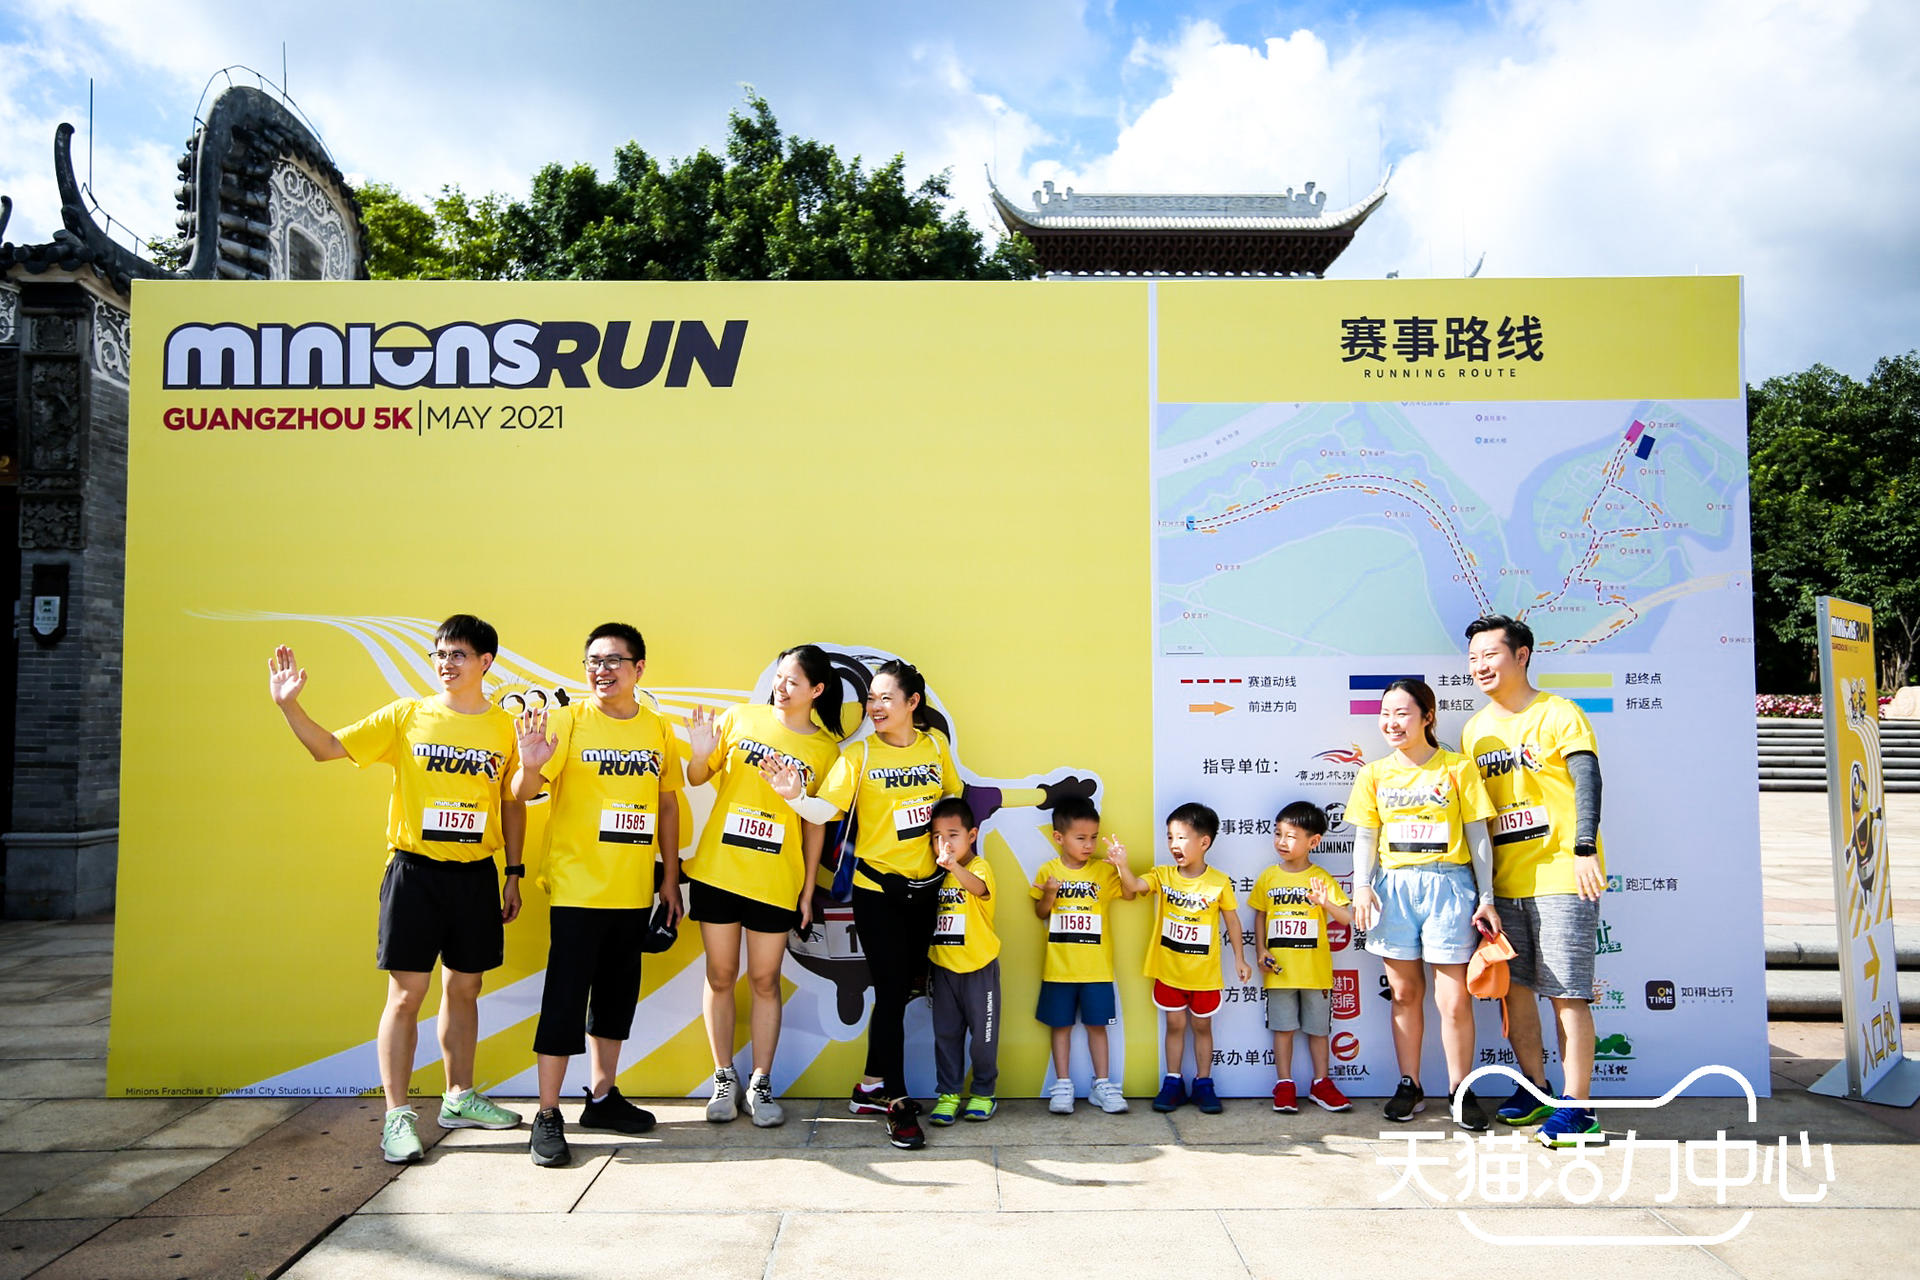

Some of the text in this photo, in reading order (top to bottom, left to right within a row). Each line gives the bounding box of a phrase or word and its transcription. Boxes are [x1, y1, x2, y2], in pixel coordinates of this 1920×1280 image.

[1341, 315, 1544, 363] 赛事路线
[1364, 368, 1517, 378] RUNNING ROUTE
[163, 406, 563, 431] GUANGZHOU 5K MAY 2021
[1248, 676, 1297, 688] 赛道动线
[1438, 674, 1474, 686] 主会场
[1625, 672, 1662, 685] 起终点
[1248, 700, 1297, 713] 前进方向
[1438, 699, 1474, 711] 集结区
[1625, 698, 1663, 710] 折返点
[426, 755, 480, 775] RUN
[598, 760, 645, 776] RUN
[885, 773, 928, 788] RUN
[439, 811, 475, 829] 11576
[615, 813, 645, 830] 11585
[907, 804, 932, 825] 1158
[1499, 810, 1533, 831] 11579
[738, 817, 773, 838] 11584
[1219, 818, 1278, 835] 事授权
[1400, 824, 1433, 839] 11577
[1626, 877, 1678, 891] 跑汇体育
[1056, 888, 1086, 898] RUN
[1273, 895, 1304, 905] RUN
[1167, 894, 1197, 908] RUN
[1060, 915, 1091, 930] 11583
[1275, 920, 1307, 936] 11578
[1169, 922, 1198, 941] 11575
[1648, 996, 1673, 1004] TIME
[126, 1087, 159, 1096] Minions
[161, 1087, 204, 1096] Franchise
[216, 1086, 256, 1095] Universal
[258, 1086, 276, 1097] City
[279, 1086, 311, 1095] Studios
[335, 1086, 347, 1095] All
[349, 1086, 377, 1097] Rights
